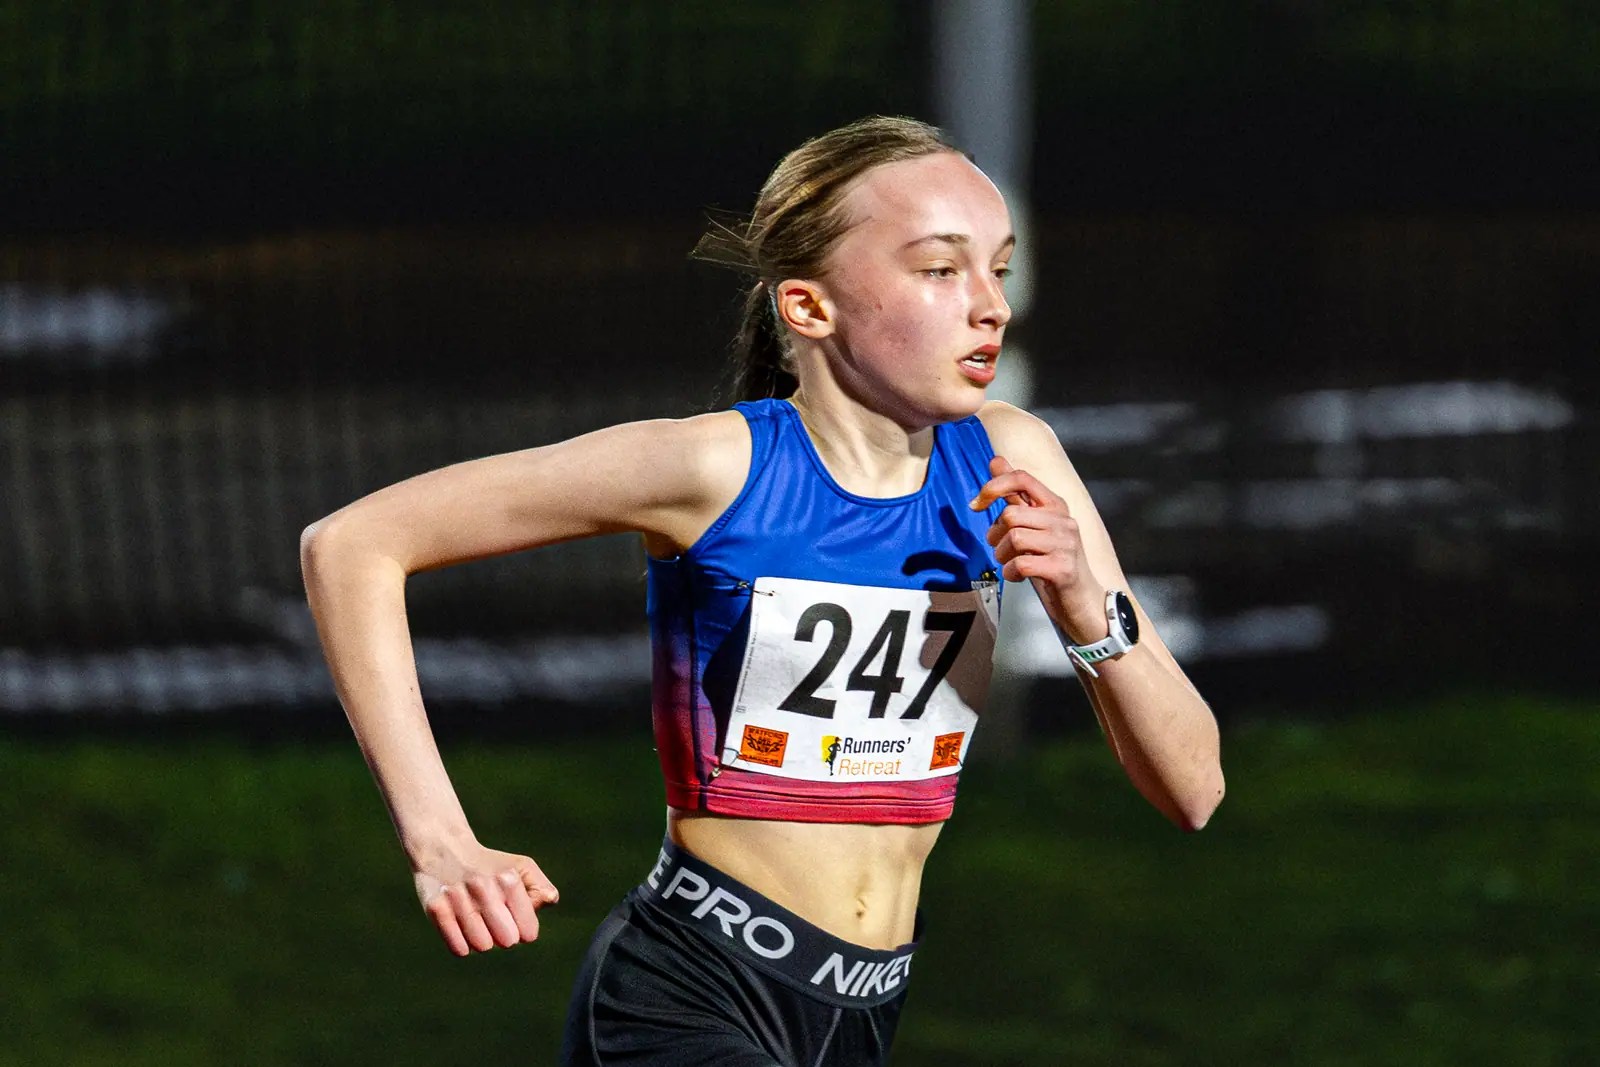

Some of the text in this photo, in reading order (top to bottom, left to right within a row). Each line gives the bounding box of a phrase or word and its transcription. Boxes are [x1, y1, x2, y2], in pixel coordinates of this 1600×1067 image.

[777, 602, 977, 720] 247
[838, 758, 902, 776] Retreat
[842, 737, 912, 754] Runners'
[661, 866, 795, 960] PRO
[810, 952, 910, 997] NIKE
